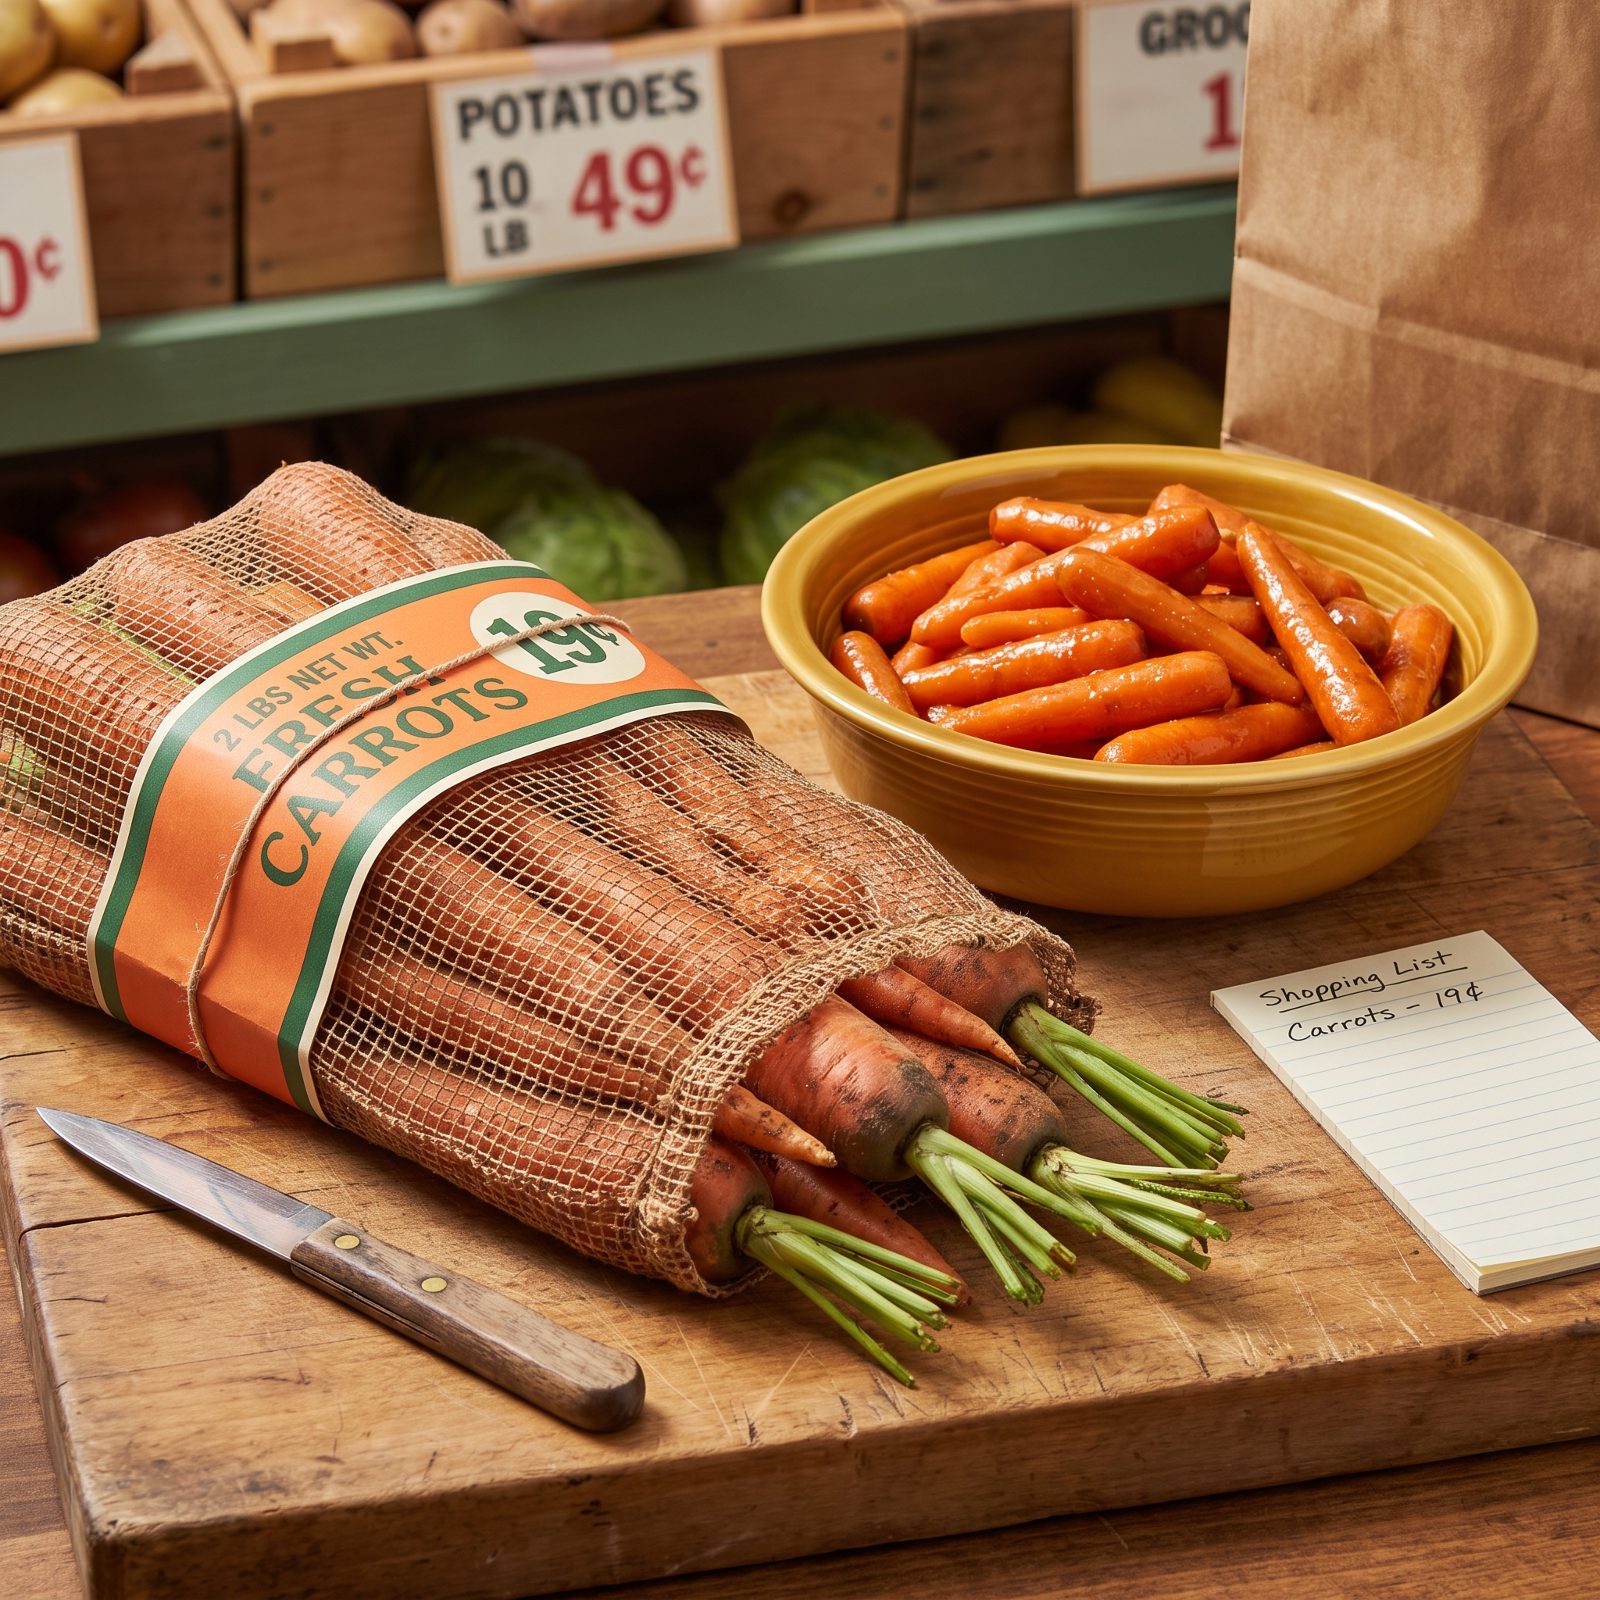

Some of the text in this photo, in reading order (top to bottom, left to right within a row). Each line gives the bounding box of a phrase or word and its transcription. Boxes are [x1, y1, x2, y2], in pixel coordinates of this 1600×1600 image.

[458, 69, 700, 141] POTATOES
[1203, 69, 1246, 152] 1
[475, 160, 530, 212] 10
[571, 145, 706, 232] 49¢
[484, 219, 530, 257] LB
[486, 610, 620, 675] 19¢
[213, 631, 404, 751] 2 LBS NET WT.
[232, 655, 446, 796] FRESH
[261, 677, 528, 887] CARROTS
[1259, 950, 1453, 1007] Shopping List
[1287, 1007, 1395, 1042] Carrots
[1435, 981, 1484, 1008] 19¢
